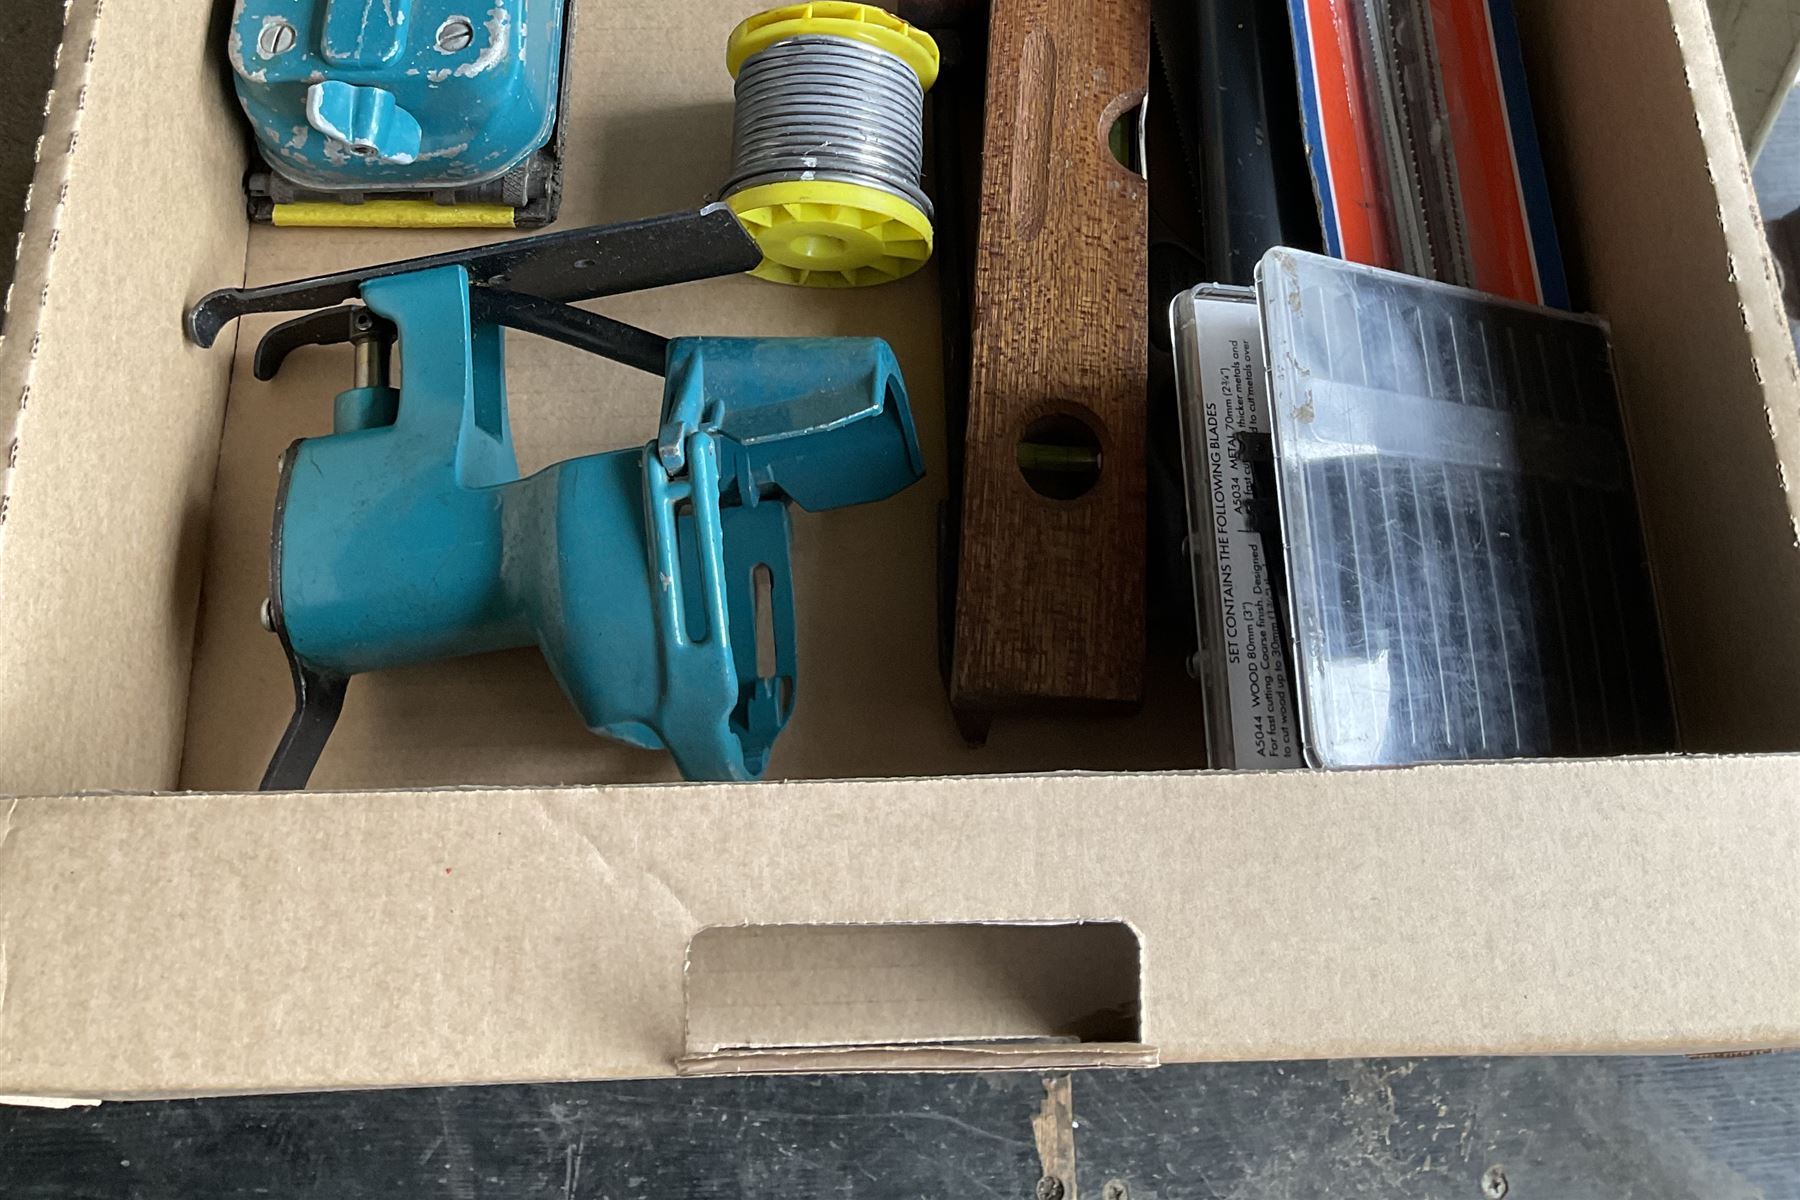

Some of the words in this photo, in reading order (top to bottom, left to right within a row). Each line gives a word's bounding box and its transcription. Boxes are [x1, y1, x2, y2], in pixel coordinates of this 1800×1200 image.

[1230, 340, 1239, 360] and
[1243, 340, 1251, 362] over
[1232, 361, 1242, 393] metals
[1245, 364, 1255, 396] metals
[1206, 402, 1220, 449] BLADES
[1225, 398, 1234, 431] 70mm
[1237, 394, 1246, 428] thicker
[1249, 414, 1257, 425] to
[1210, 452, 1228, 534] FOLLOWING
[1232, 477, 1242, 515] A5034
[1244, 476, 1252, 496] fast
[1219, 537, 1230, 561] THE
[1249, 544, 1262, 594] Designed
[1222, 564, 1238, 638] CONTAINS
[1228, 641, 1240, 664] SET
[1247, 624, 1257, 660] 80mm
[1261, 630, 1270, 671] Coarse
[1271, 622, 1281, 657] 30mm
[1273, 660, 1282, 671] to
[1277, 673, 1286, 688] up
[1249, 662, 1260, 708] WOOD
[1277, 690, 1288, 724] wood
[1254, 716, 1266, 757] A5044
[1267, 715, 1277, 735] fast
[1282, 727, 1290, 743] cut
[1270, 737, 1279, 757] For
[1283, 746, 1291, 758] to
